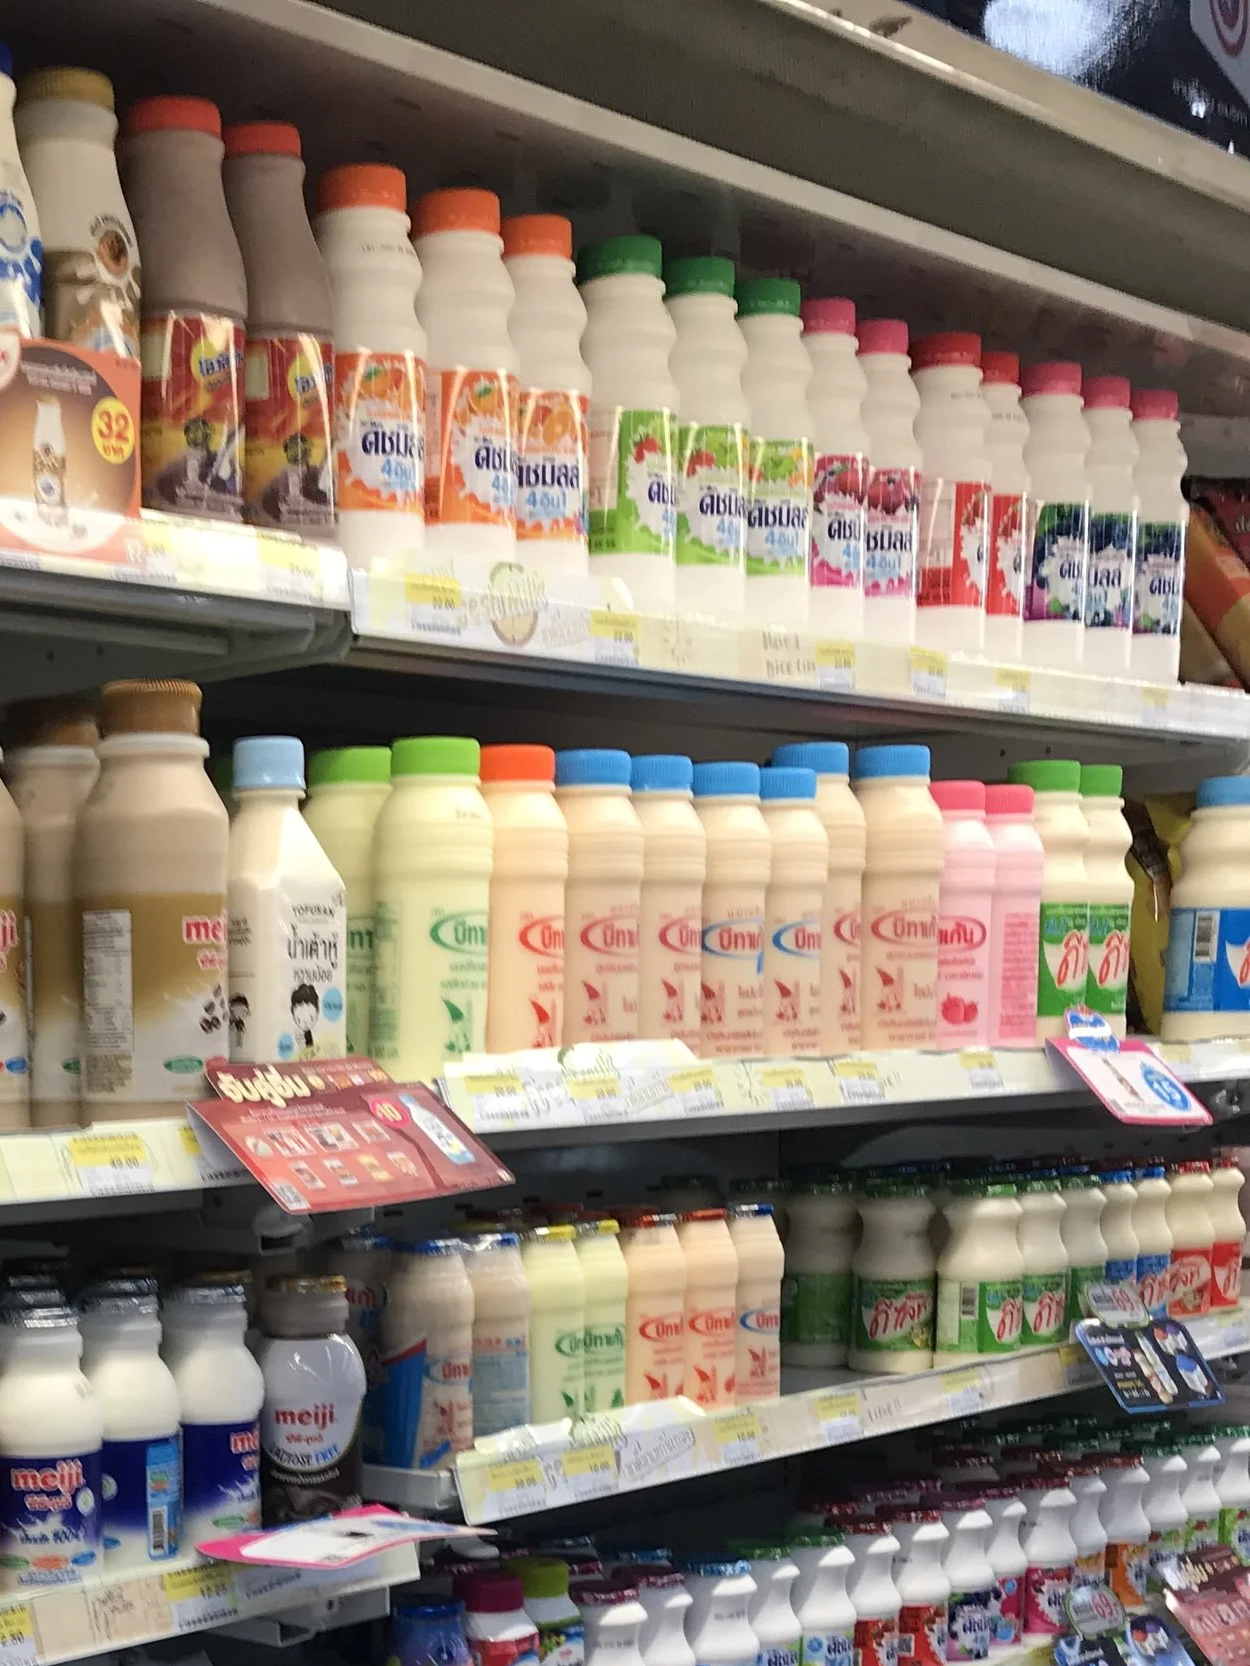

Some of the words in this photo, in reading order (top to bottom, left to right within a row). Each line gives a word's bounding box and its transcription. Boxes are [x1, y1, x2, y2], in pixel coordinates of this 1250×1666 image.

[95, 414, 132, 444] 32
[291, 904, 336, 918] TOFUSAN
[286, 920, 340, 970] น้ำเต้าหู้
[274, 1401, 336, 1432] meiji
[10, 1458, 84, 1492] meiji
